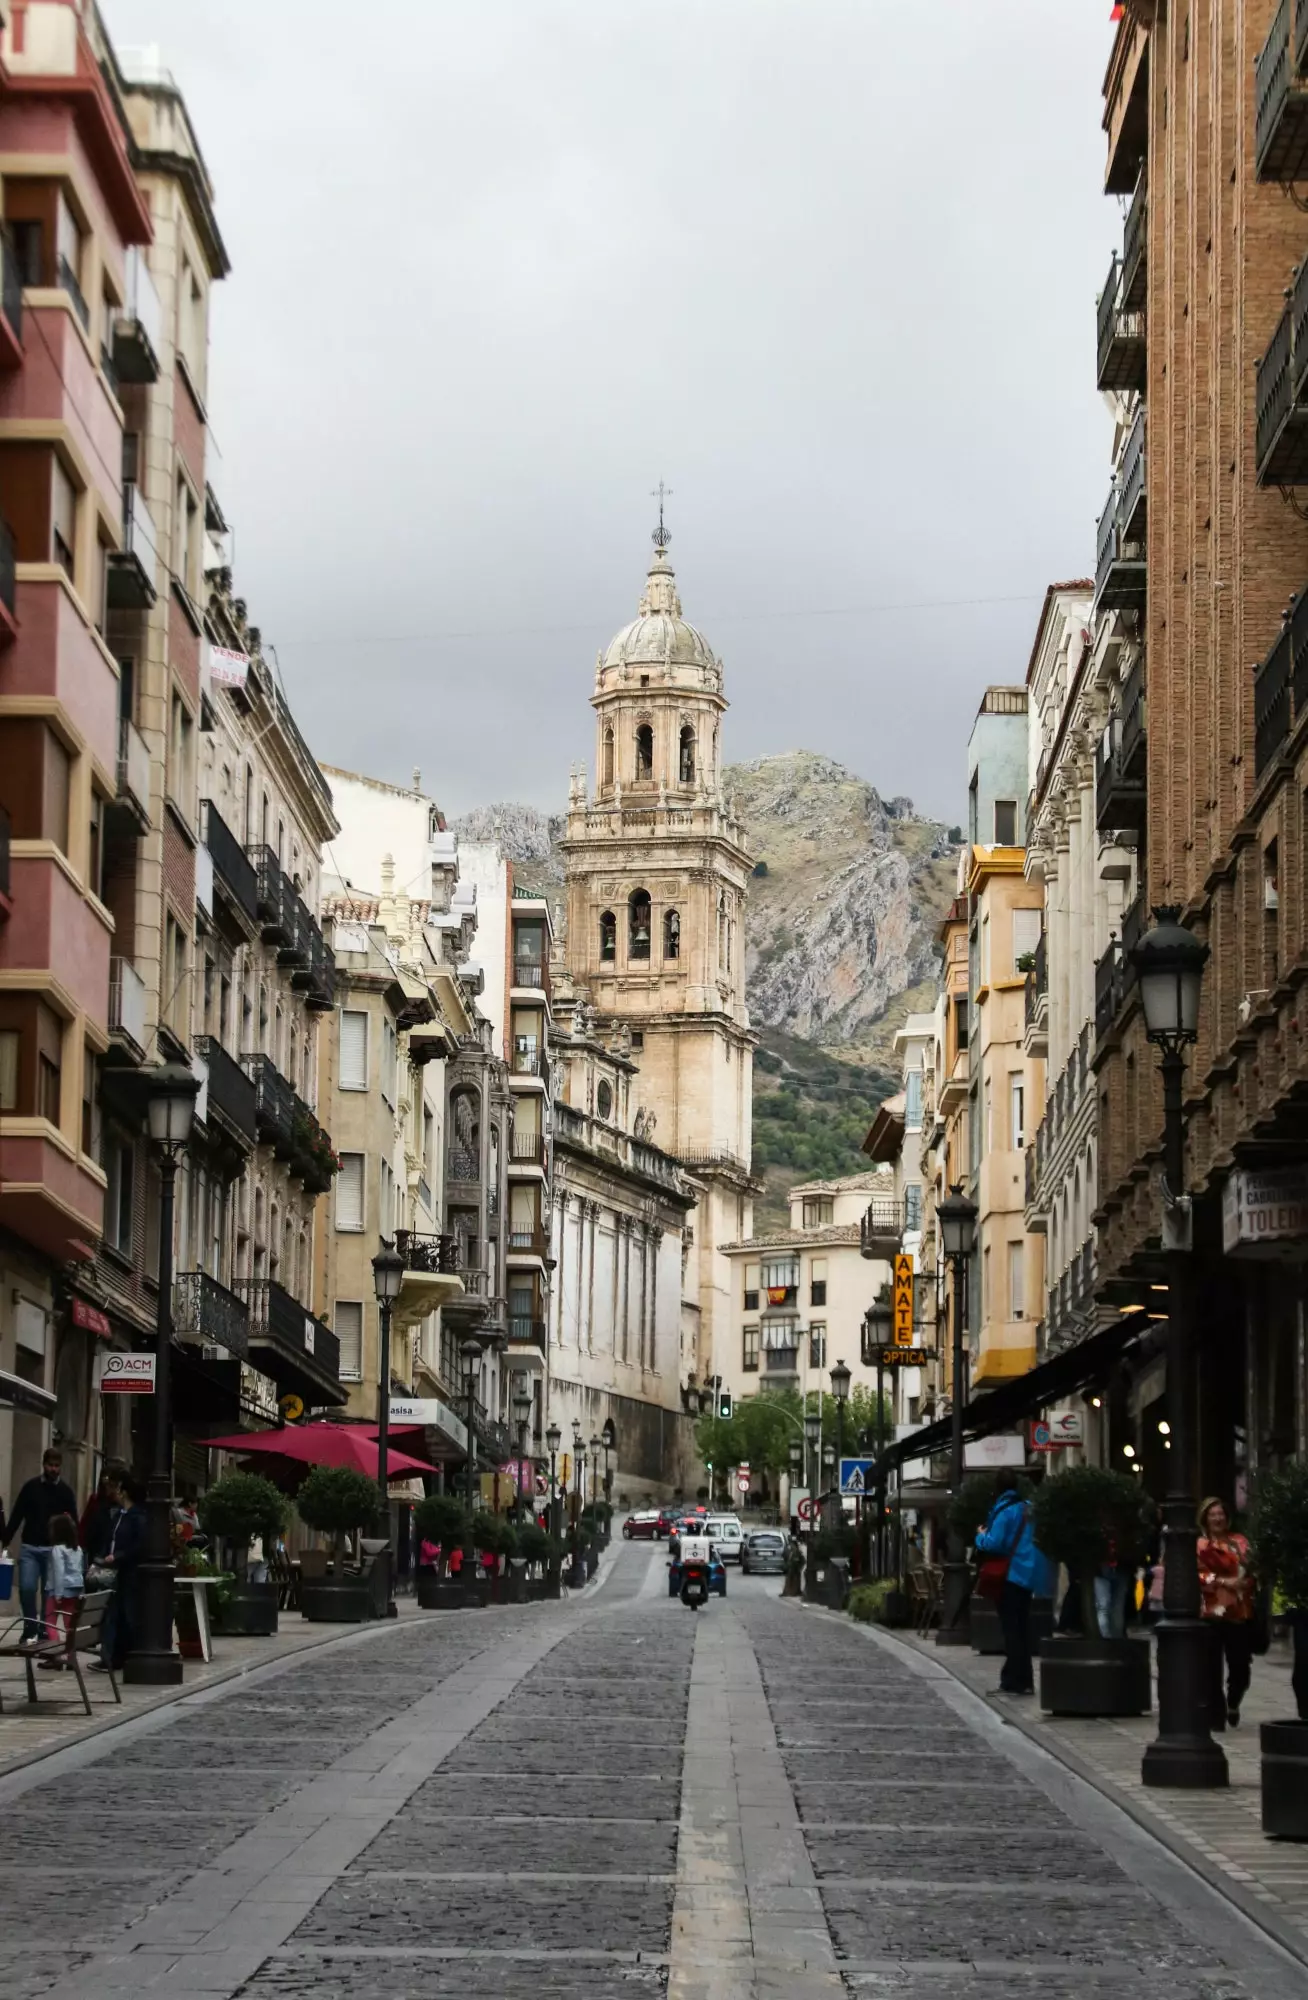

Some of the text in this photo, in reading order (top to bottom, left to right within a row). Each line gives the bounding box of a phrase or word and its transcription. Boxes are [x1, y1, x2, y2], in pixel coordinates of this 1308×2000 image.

[212, 646, 249, 663] VENDE
[896, 1257, 911, 1342] AMATE
[124, 1359, 152, 1370] ACM
[883, 1351, 926, 1365] OPTICA
[390, 1406, 413, 1415] asisa
